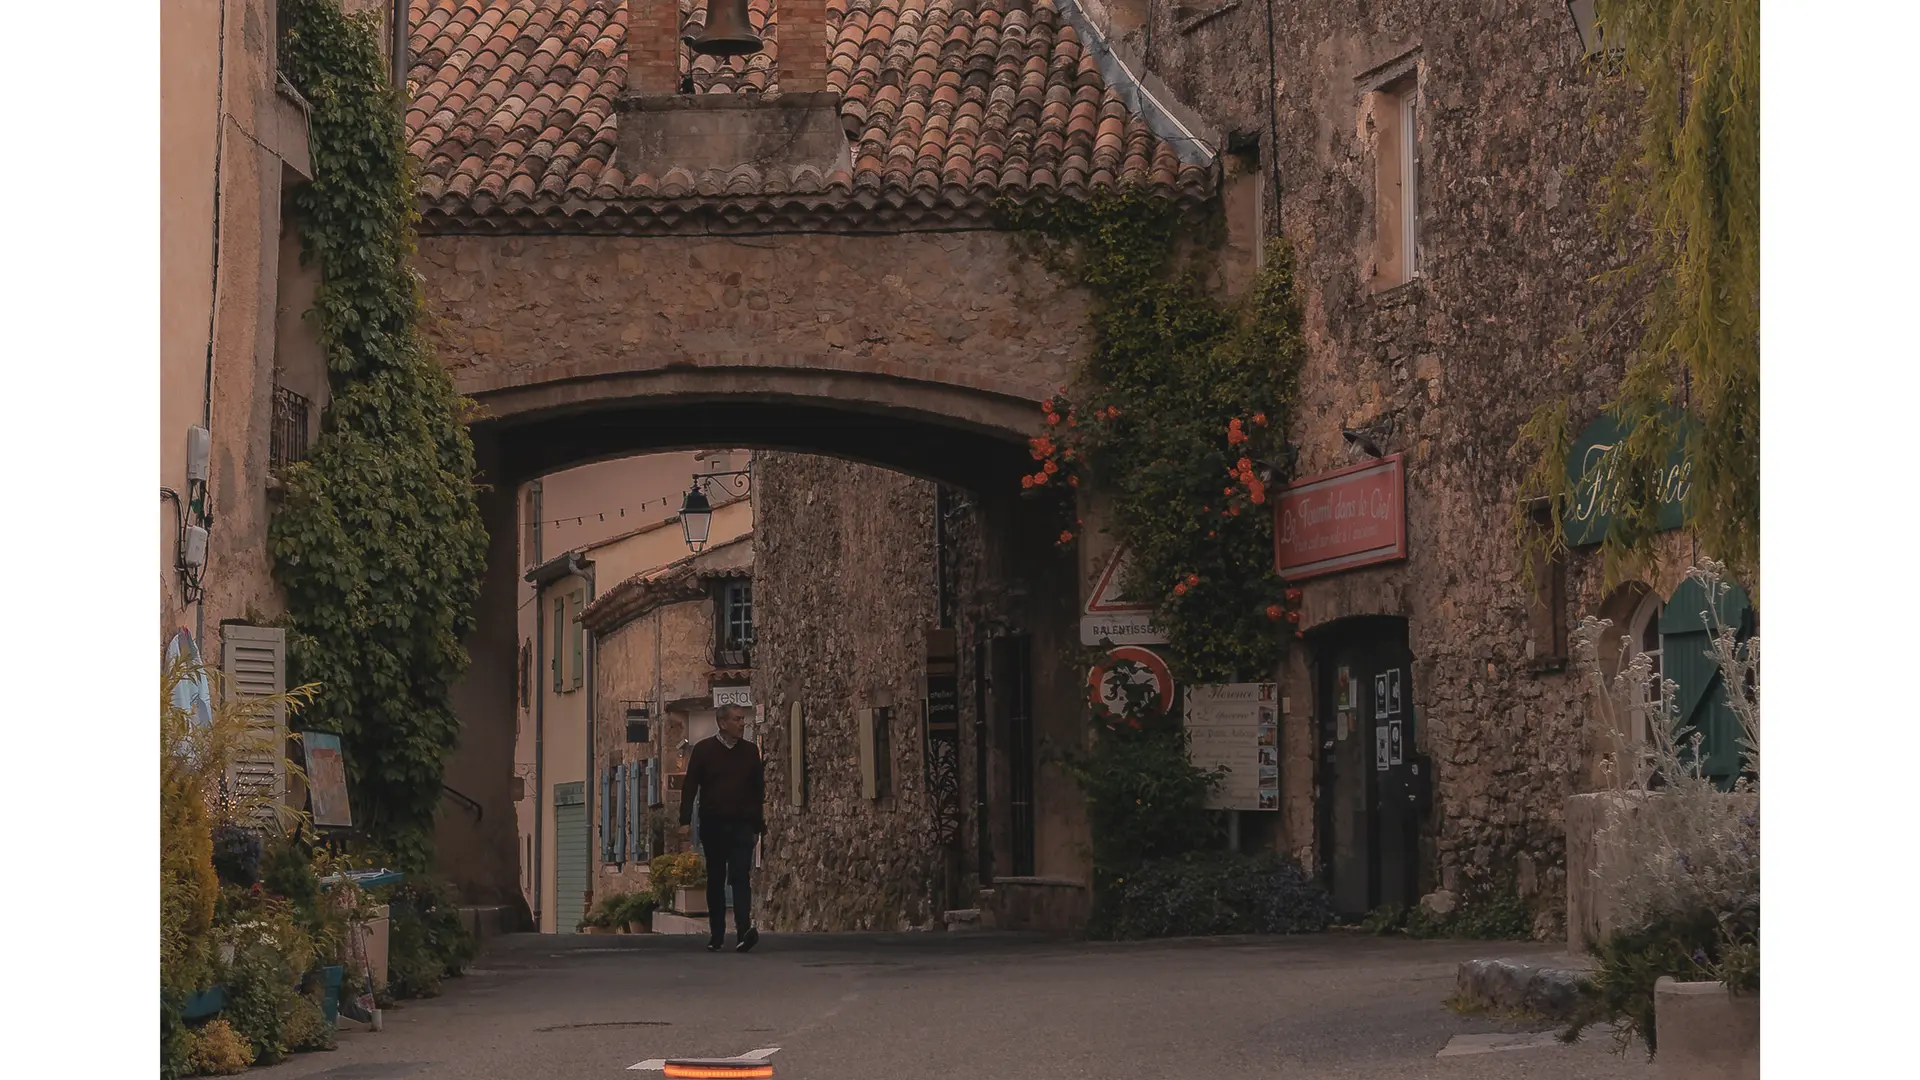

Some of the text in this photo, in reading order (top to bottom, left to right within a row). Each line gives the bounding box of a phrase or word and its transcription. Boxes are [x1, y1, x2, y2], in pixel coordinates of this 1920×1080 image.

[1577, 440, 1692, 520] Flnce
[1335, 490, 1356, 520] dans
[1358, 488, 1367, 517] le
[1370, 487, 1392, 521] Ciel
[1093, 624, 1165, 635] RALENTISSEUR
[930, 689, 954, 699] atelier
[1208, 684, 1253, 699] Florence
[930, 701, 954, 713] galerie
